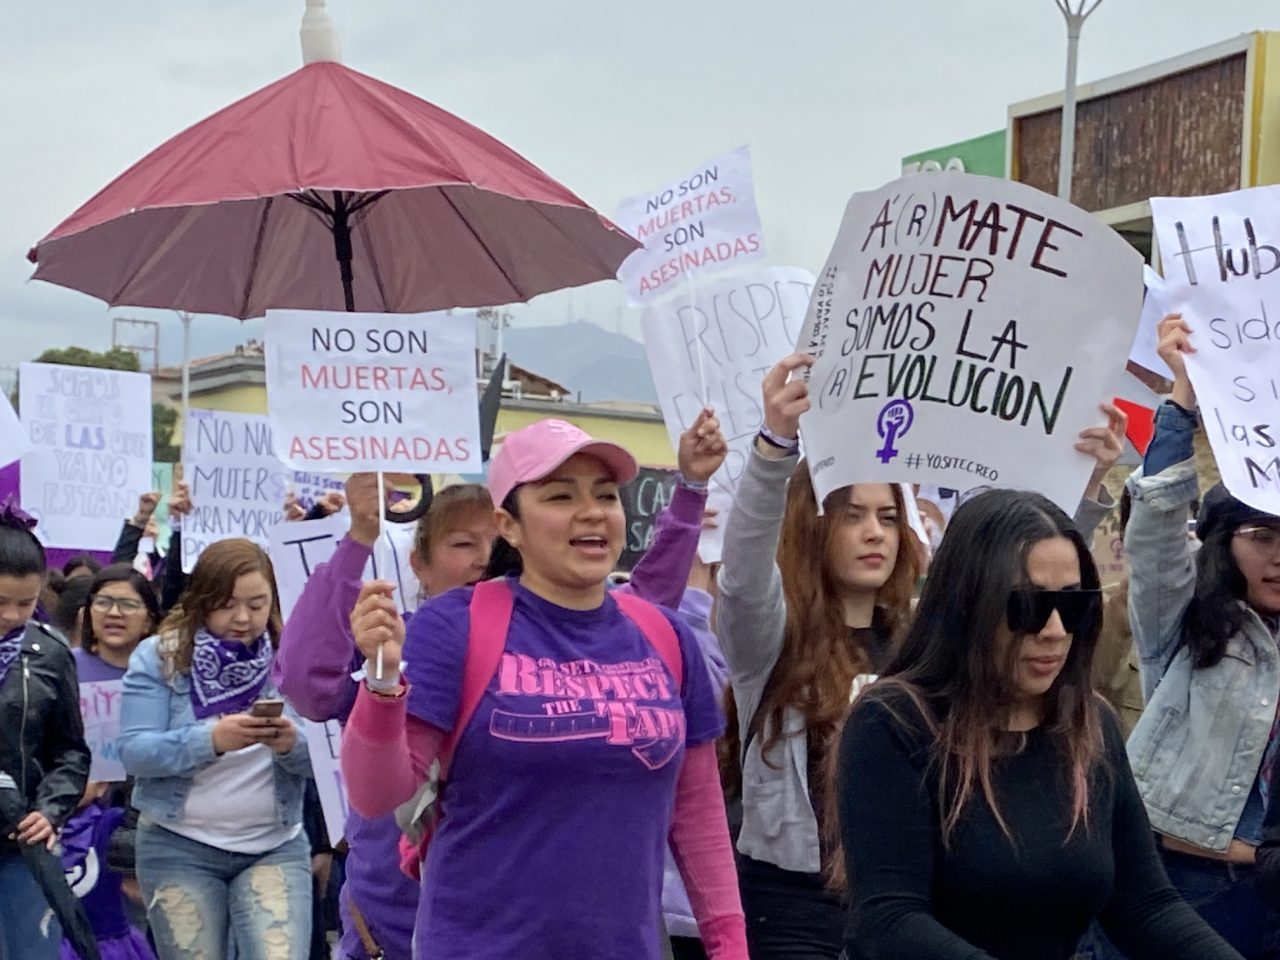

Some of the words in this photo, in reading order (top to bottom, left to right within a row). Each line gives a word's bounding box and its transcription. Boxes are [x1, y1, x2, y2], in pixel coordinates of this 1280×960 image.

[646, 188, 674, 214] NO
[678, 165, 719, 198] SON
[636, 185, 737, 240] MUERTAS,
[663, 220, 705, 252] SON
[638, 232, 761, 296] ASESINADAS
[862, 252, 996, 303] MUJER
[311, 327, 356, 352] NO
[366, 328, 428, 354] SON
[840, 301, 937, 357] SOMOS
[955, 308, 1029, 370] LA
[46, 367, 120, 401] SOMOS
[301, 364, 453, 395] MUERTAS,
[341, 400, 403, 425] SON
[30, 420, 58, 447] DE
[65, 423, 106, 450] LAS
[197, 418, 234, 455] NO
[289, 435, 471, 462] ASESINADAS
[54, 449, 88, 484] YA
[91, 453, 129, 488] NO
[193, 466, 269, 502] MUJER
[542, 699, 582, 716] THE
